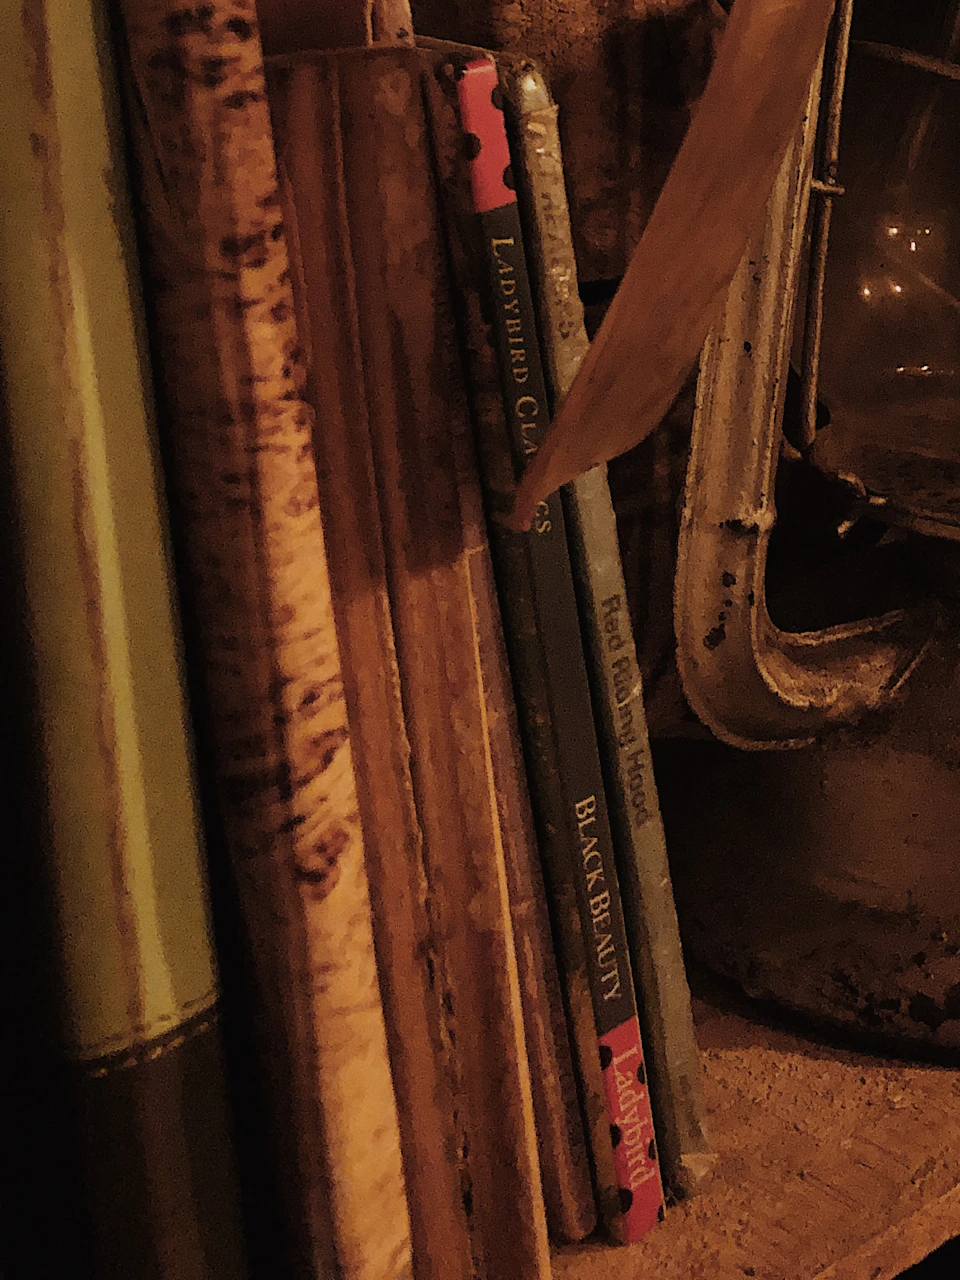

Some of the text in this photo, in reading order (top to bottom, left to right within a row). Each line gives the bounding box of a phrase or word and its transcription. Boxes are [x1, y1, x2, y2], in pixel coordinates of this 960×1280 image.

[492, 237, 551, 535] LADYBIRD CLACS
[601, 594, 624, 652] Red
[627, 748, 652, 829] Hood
[575, 795, 622, 1002] BLACK BEAUTY
[613, 1046, 656, 1190] Ladybird
